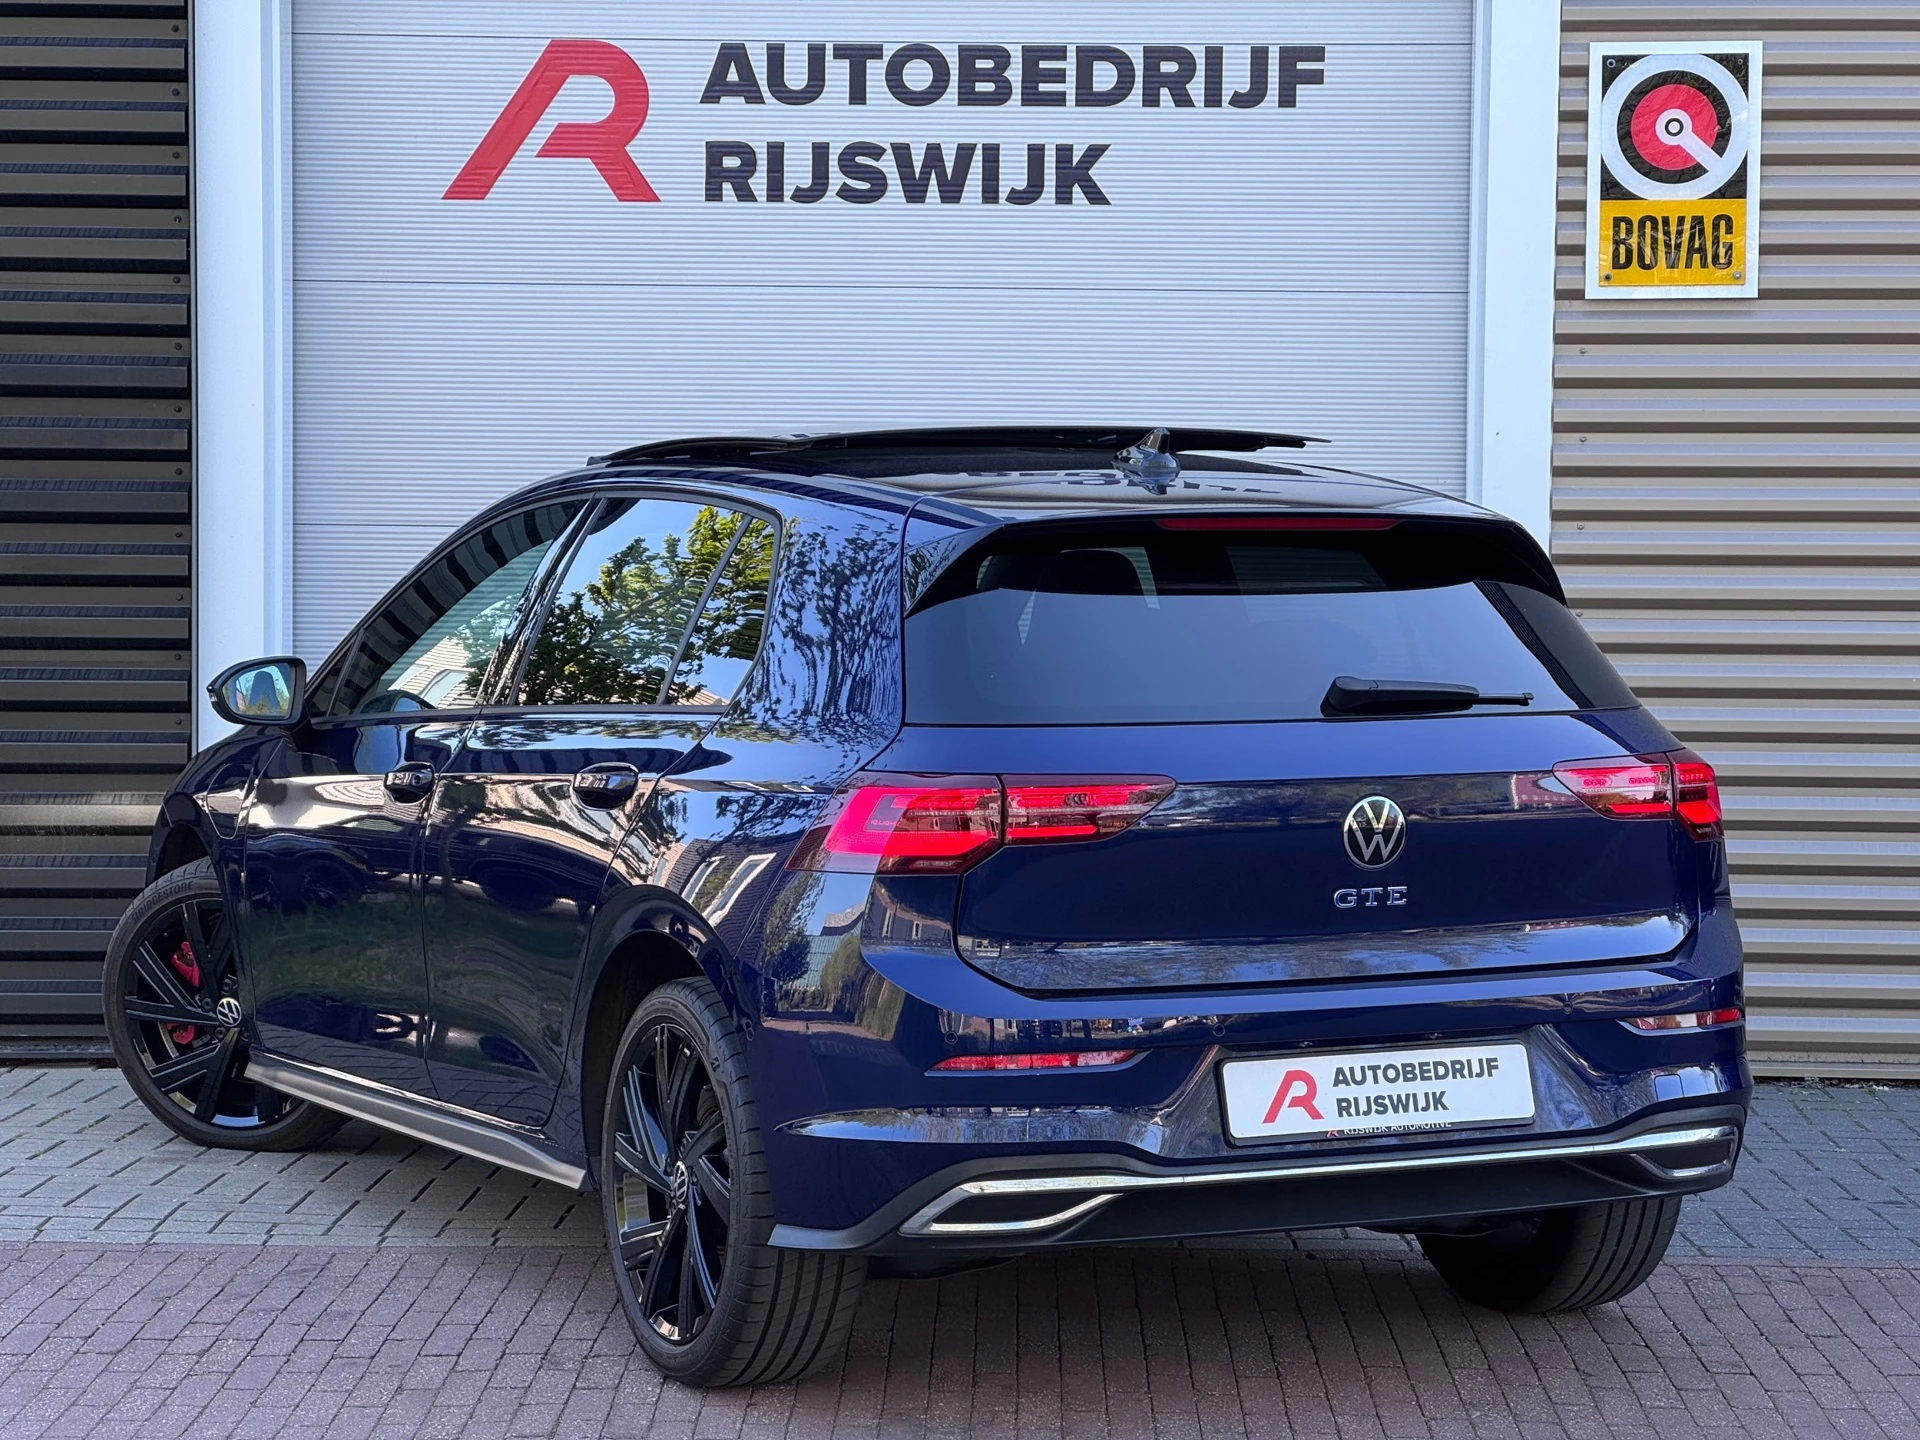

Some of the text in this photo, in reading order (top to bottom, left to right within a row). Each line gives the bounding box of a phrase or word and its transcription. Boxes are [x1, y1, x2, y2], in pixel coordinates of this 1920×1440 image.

[700, 43, 1326, 108] AUTOBEDRIJF
[704, 141, 1112, 205] RIJSWIJK
[1611, 214, 1734, 271] BOVAG
[1333, 886, 1408, 908] GTE
[1332, 1057, 1500, 1088] AUTOBEDRIJF
[1336, 1090, 1450, 1118] RIJSWIJK
